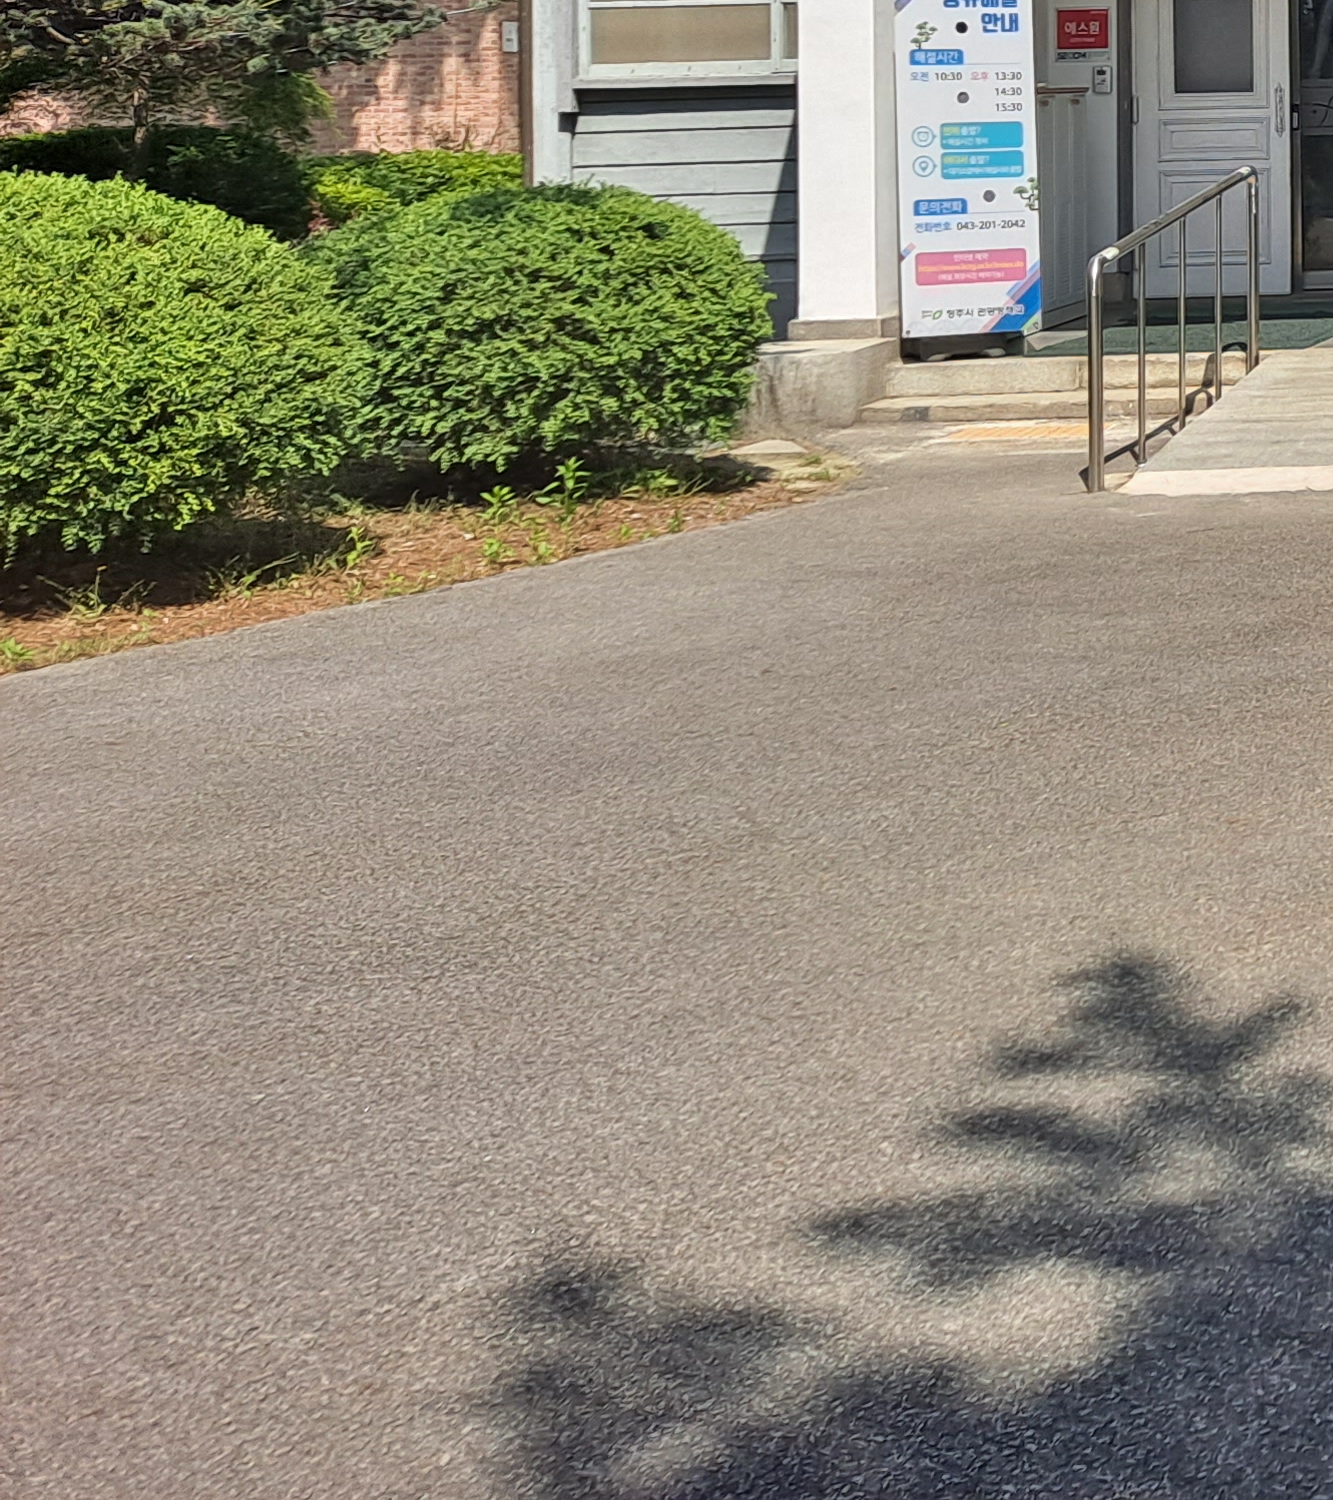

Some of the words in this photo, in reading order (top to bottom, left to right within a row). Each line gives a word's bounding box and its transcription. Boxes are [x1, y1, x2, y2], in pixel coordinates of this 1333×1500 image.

[981, 12, 1019, 33] 안내
[1064, 21, 1100, 35] 에스원
[914, 50, 959, 64] 해설시간
[935, 71, 963, 81] 10:30
[994, 71, 1023, 81] 13:30
[994, 87, 1023, 96] 14:30
[994, 102, 1023, 112] 15:30
[920, 200, 963, 214] 문의전화
[914, 221, 952, 233] 전화번호
[956, 219, 1026, 231] 043-201-2042
